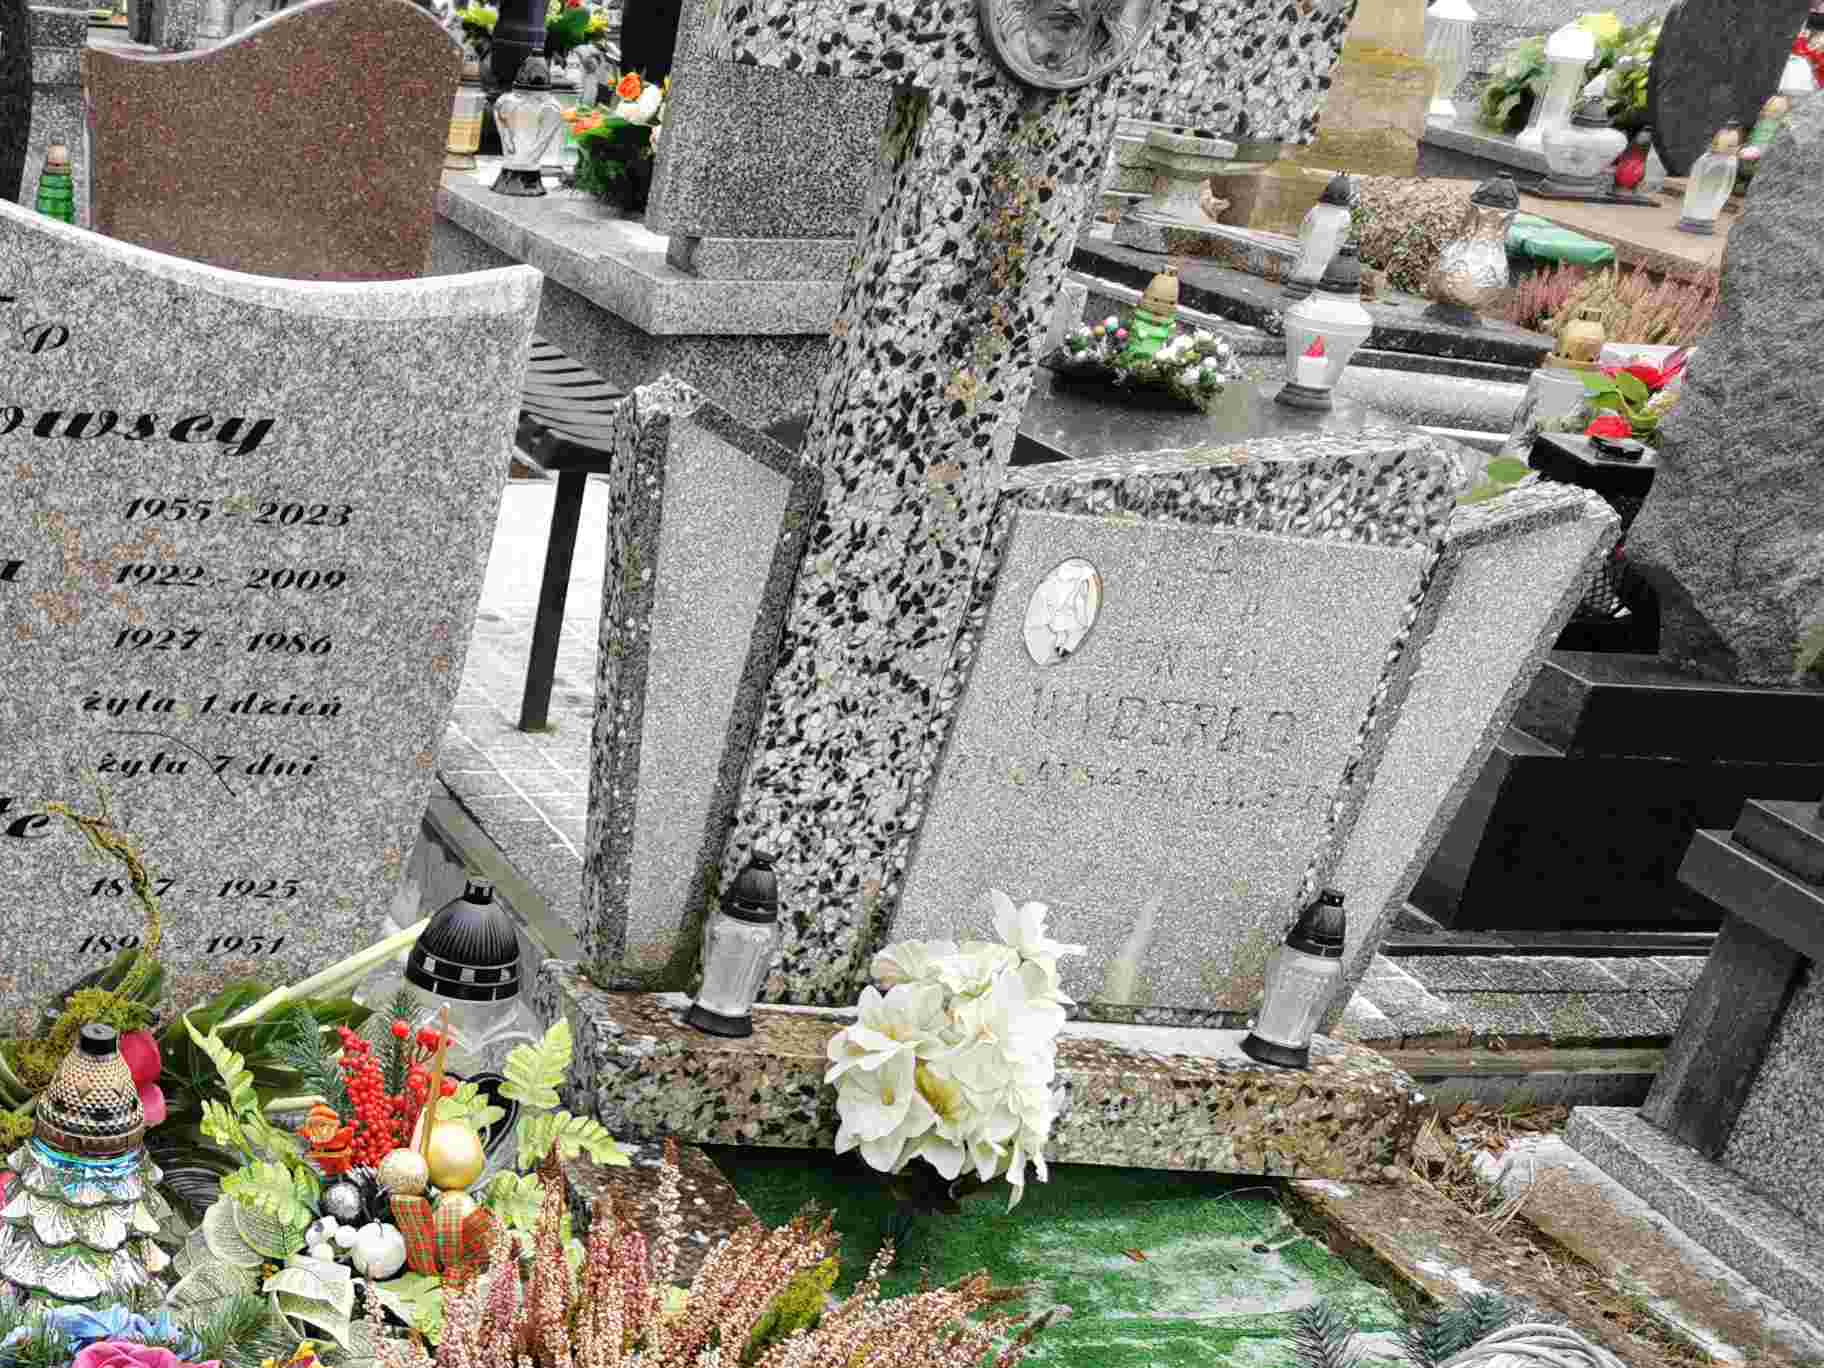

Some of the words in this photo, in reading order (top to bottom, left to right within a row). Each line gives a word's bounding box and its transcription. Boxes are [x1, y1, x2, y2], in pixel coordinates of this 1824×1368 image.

[126, 499, 213, 521] 1955
[251, 503, 353, 528] 2023
[115, 564, 206, 588] 1922
[242, 567, 348, 591] 2009
[112, 628, 205, 651] 1927
[246, 631, 333, 656] 1986
[245, 752, 320, 777] dni
[89, 876, 176, 898] 187
[216, 878, 300, 899] 1925
[204, 935, 286, 953] 1951
